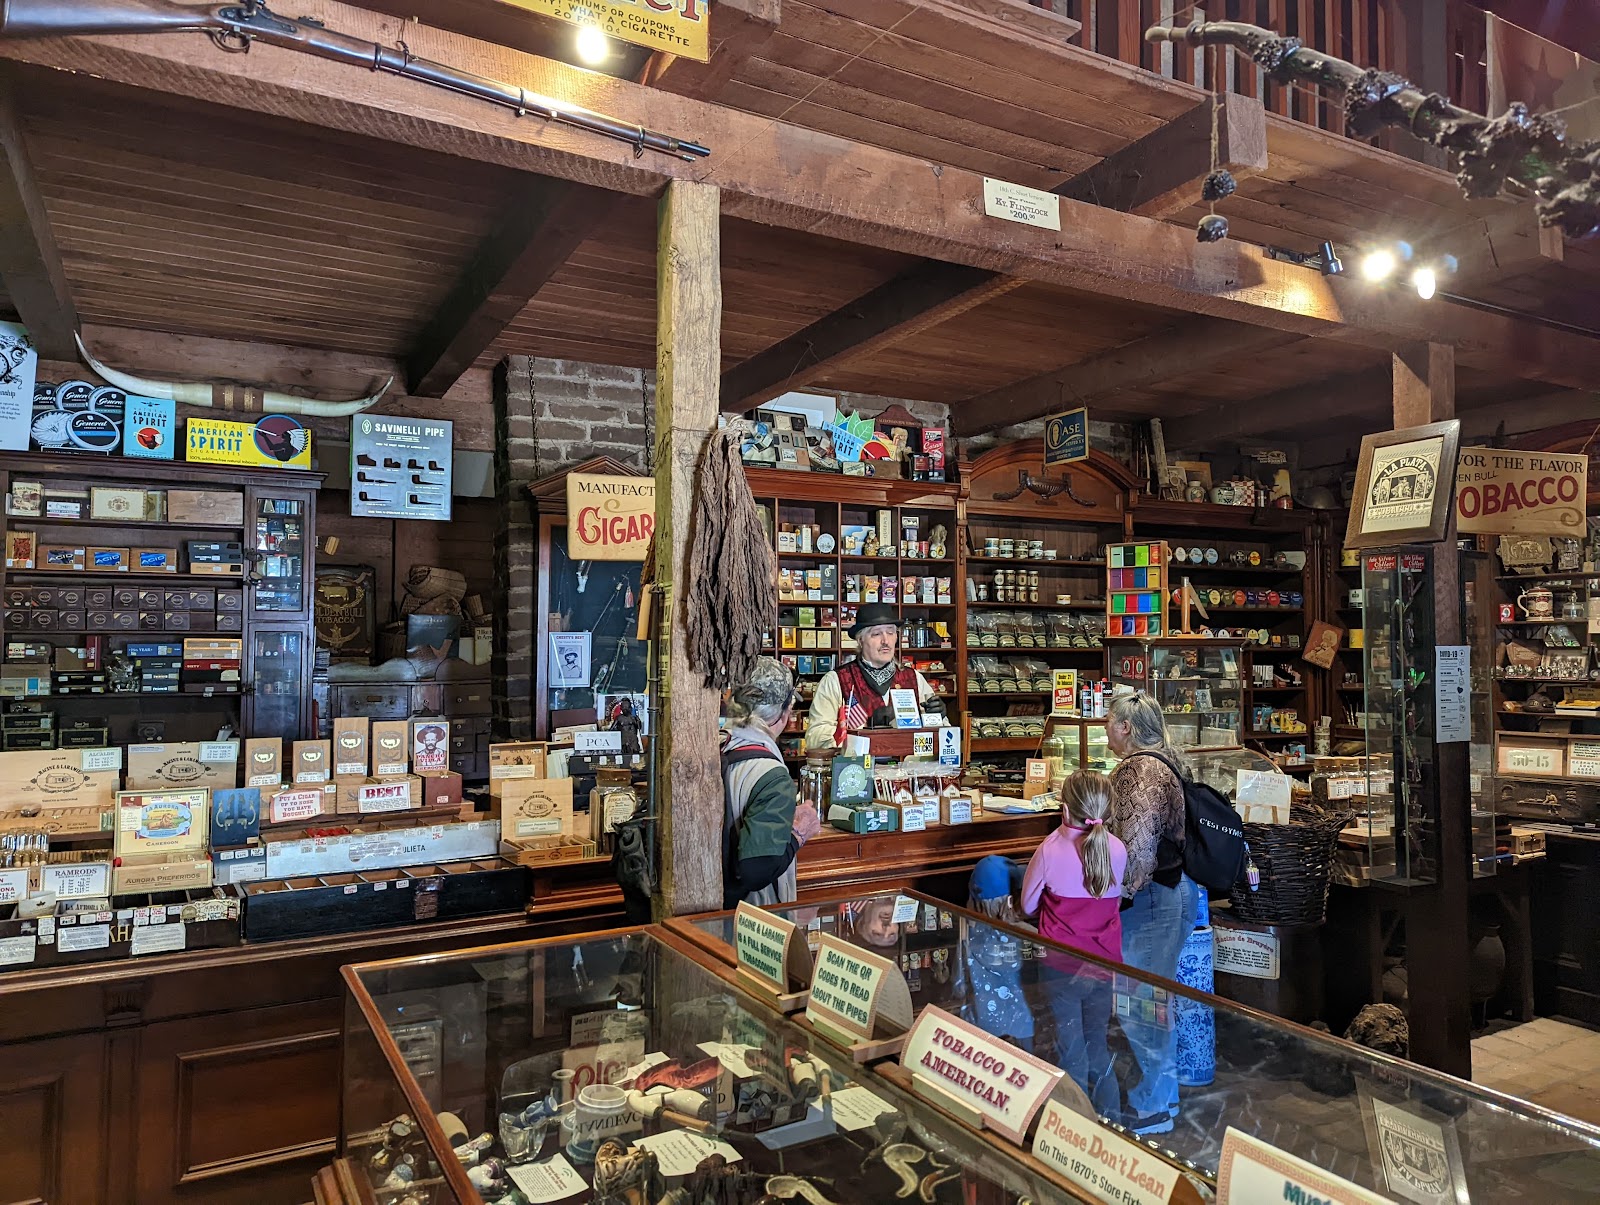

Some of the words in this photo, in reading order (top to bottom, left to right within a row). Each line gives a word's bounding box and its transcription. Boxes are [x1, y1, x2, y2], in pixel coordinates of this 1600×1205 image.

[554, 8, 572, 19] 20
[577, 15, 597, 26] FOR
[610, 8, 624, 18] OR
[628, 13, 676, 33] COUPONS
[568, 3, 602, 20] WHAT
[607, 16, 615, 24] A
[620, 20, 690, 47] CIGARETTE
[133, 410, 167, 419] AMERICAN
[74, 416, 108, 428] General
[133, 416, 167, 427] SPIRIT
[190, 420, 243, 430] NATURAL
[189, 427, 243, 438] AMERICAN
[374, 423, 421, 435] SAVINELLI
[424, 427, 445, 437] PIPE
[189, 434, 243, 452] SPIRIT
[190, 448, 241, 456] CIGARETTES
[1384, 464, 1398, 477] LA
[1399, 458, 1425, 471] PLATA
[1492, 456, 1524, 470] THE
[1529, 458, 1584, 474] FLAVOR
[1474, 470, 1499, 482] BULL
[1457, 475, 1579, 519] OBACCO
[1373, 506, 1415, 516] TOBACCO
[48, 553, 74, 562] ACID
[95, 555, 120, 564] ACID
[140, 555, 165, 564] ACID
[344, 607, 365, 618] BULL
[316, 616, 355, 624] TOBACCO
[1439, 650, 1458, 658] COVID-19
[1055, 695, 1073, 704] Card
[586, 738, 611, 747] PCA
[914, 745, 933, 753] STICKS
[1268, 776, 1286, 785] Pelts
[365, 785, 405, 799] BEST
[145, 805, 153, 813] LA
[306, 808, 317, 816] IT!
[1199, 817, 1220, 830] C'EST
[1221, 825, 1243, 838] GYMS
[54, 868, 97, 877] RAMRODS
[125, 877, 155, 885] AURORA
[156, 872, 201, 882] PREFERIDOS
[738, 914, 756, 932] RACINE
[756, 924, 761, 934] &
[761, 924, 785, 946] LARAMIE
[1215, 936, 1236, 944] Racine
[737, 932, 743, 942] IS
[742, 935, 747, 945] A
[747, 938, 759, 952] FULL
[760, 945, 782, 964] SERVICE
[742, 950, 777, 979] TOBACCONIST
[826, 950, 846, 967] SCAN
[846, 959, 860, 973] THE
[860, 965, 873, 981] QR
[818, 967, 838, 987] CODES
[839, 976, 849, 993] TO
[850, 982, 870, 1002] READ
[811, 985, 832, 1004] ABOUT
[832, 995, 845, 1011] THE
[845, 1002, 868, 1024] PIPES
[932, 1027, 1006, 1077] TOBACCO
[1005, 1066, 1031, 1089] IS
[920, 1050, 1011, 1113] AMERICAN.
[1043, 1109, 1087, 1152] Please
[1087, 1133, 1128, 1175] Don't
[1127, 1156, 1166, 1201] Lean
[1038, 1138, 1050, 1155] On
[1050, 1146, 1069, 1166] This
[1070, 1155, 1099, 1184] 1870's
[1099, 1176, 1121, 1199] Store
